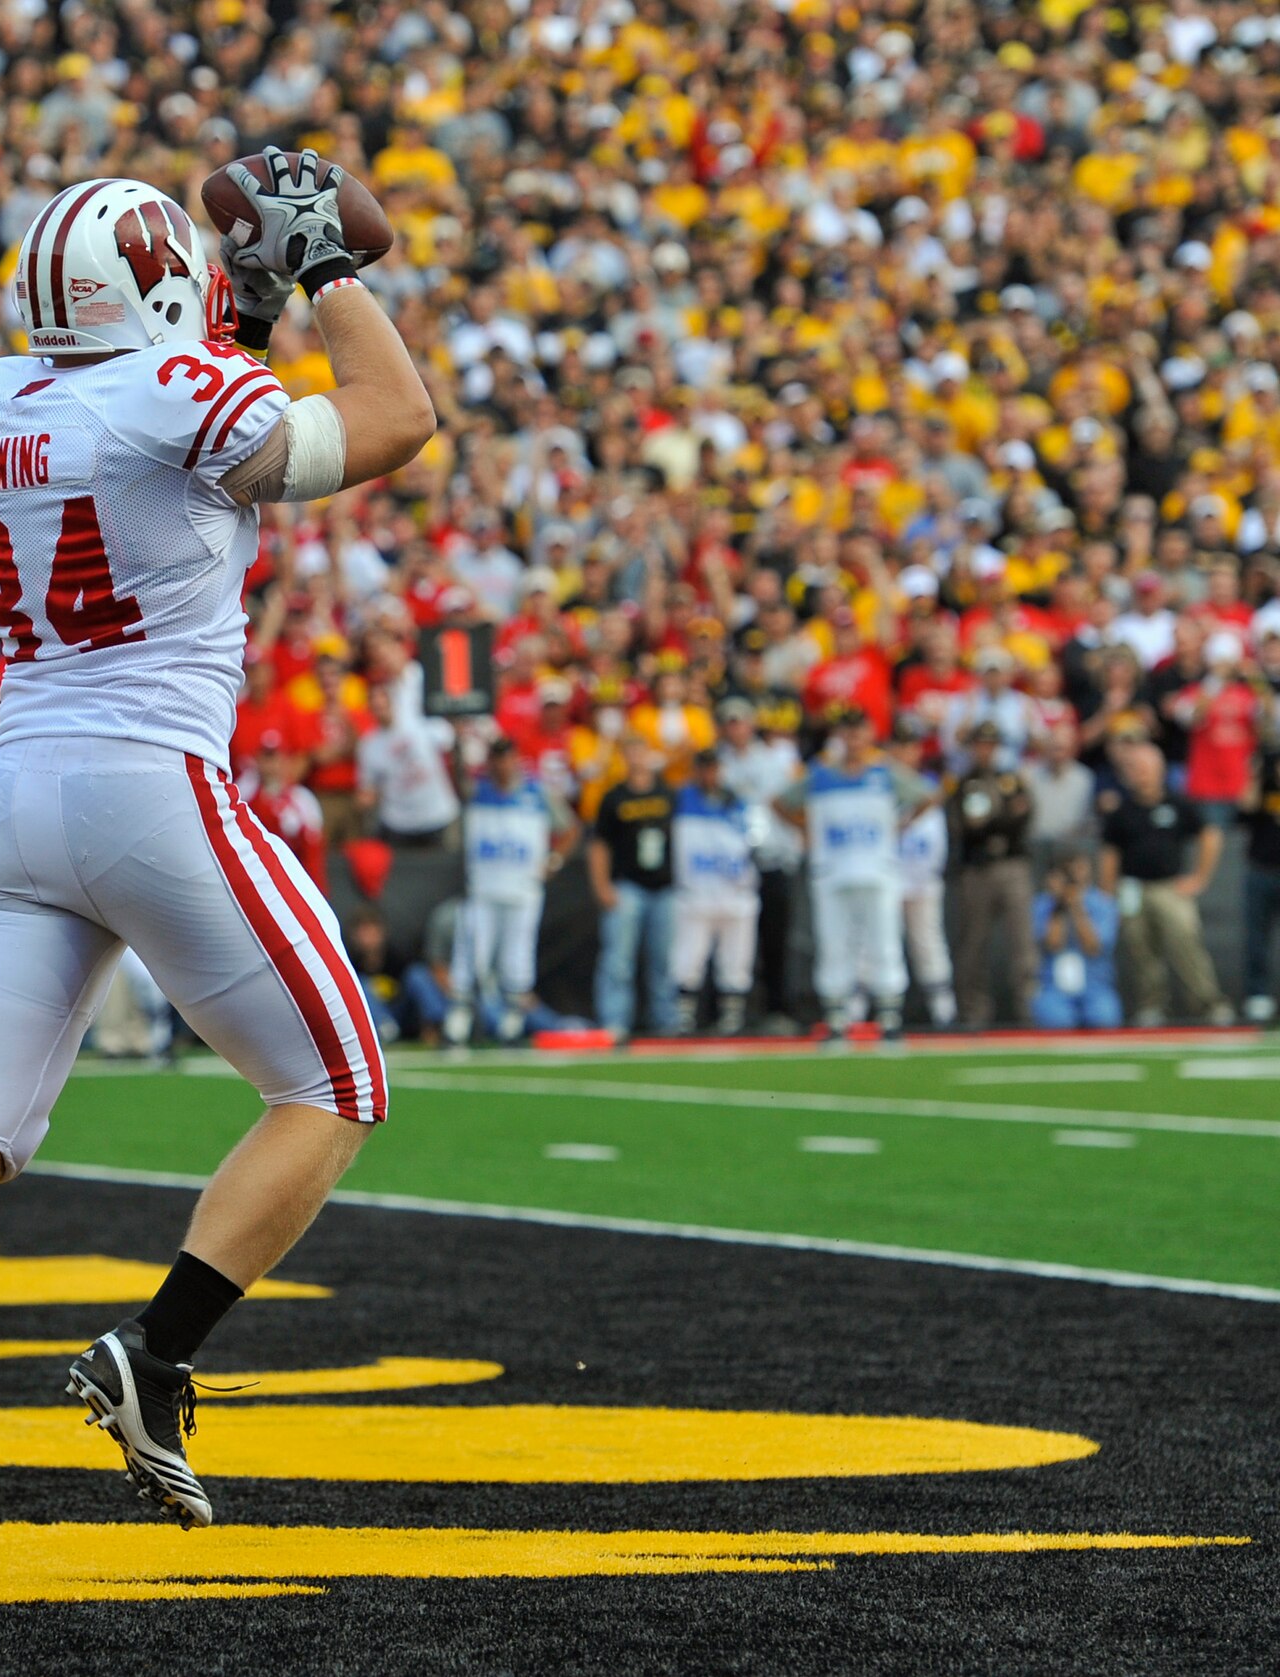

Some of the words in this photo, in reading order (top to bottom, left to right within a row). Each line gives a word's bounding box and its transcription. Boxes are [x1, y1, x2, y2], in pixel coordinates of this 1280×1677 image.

[71, 285, 93, 293] NCAA
[33, 335, 75, 347] Riddell
[157, 341, 262, 403] 34
[437, 627, 472, 698] 1
